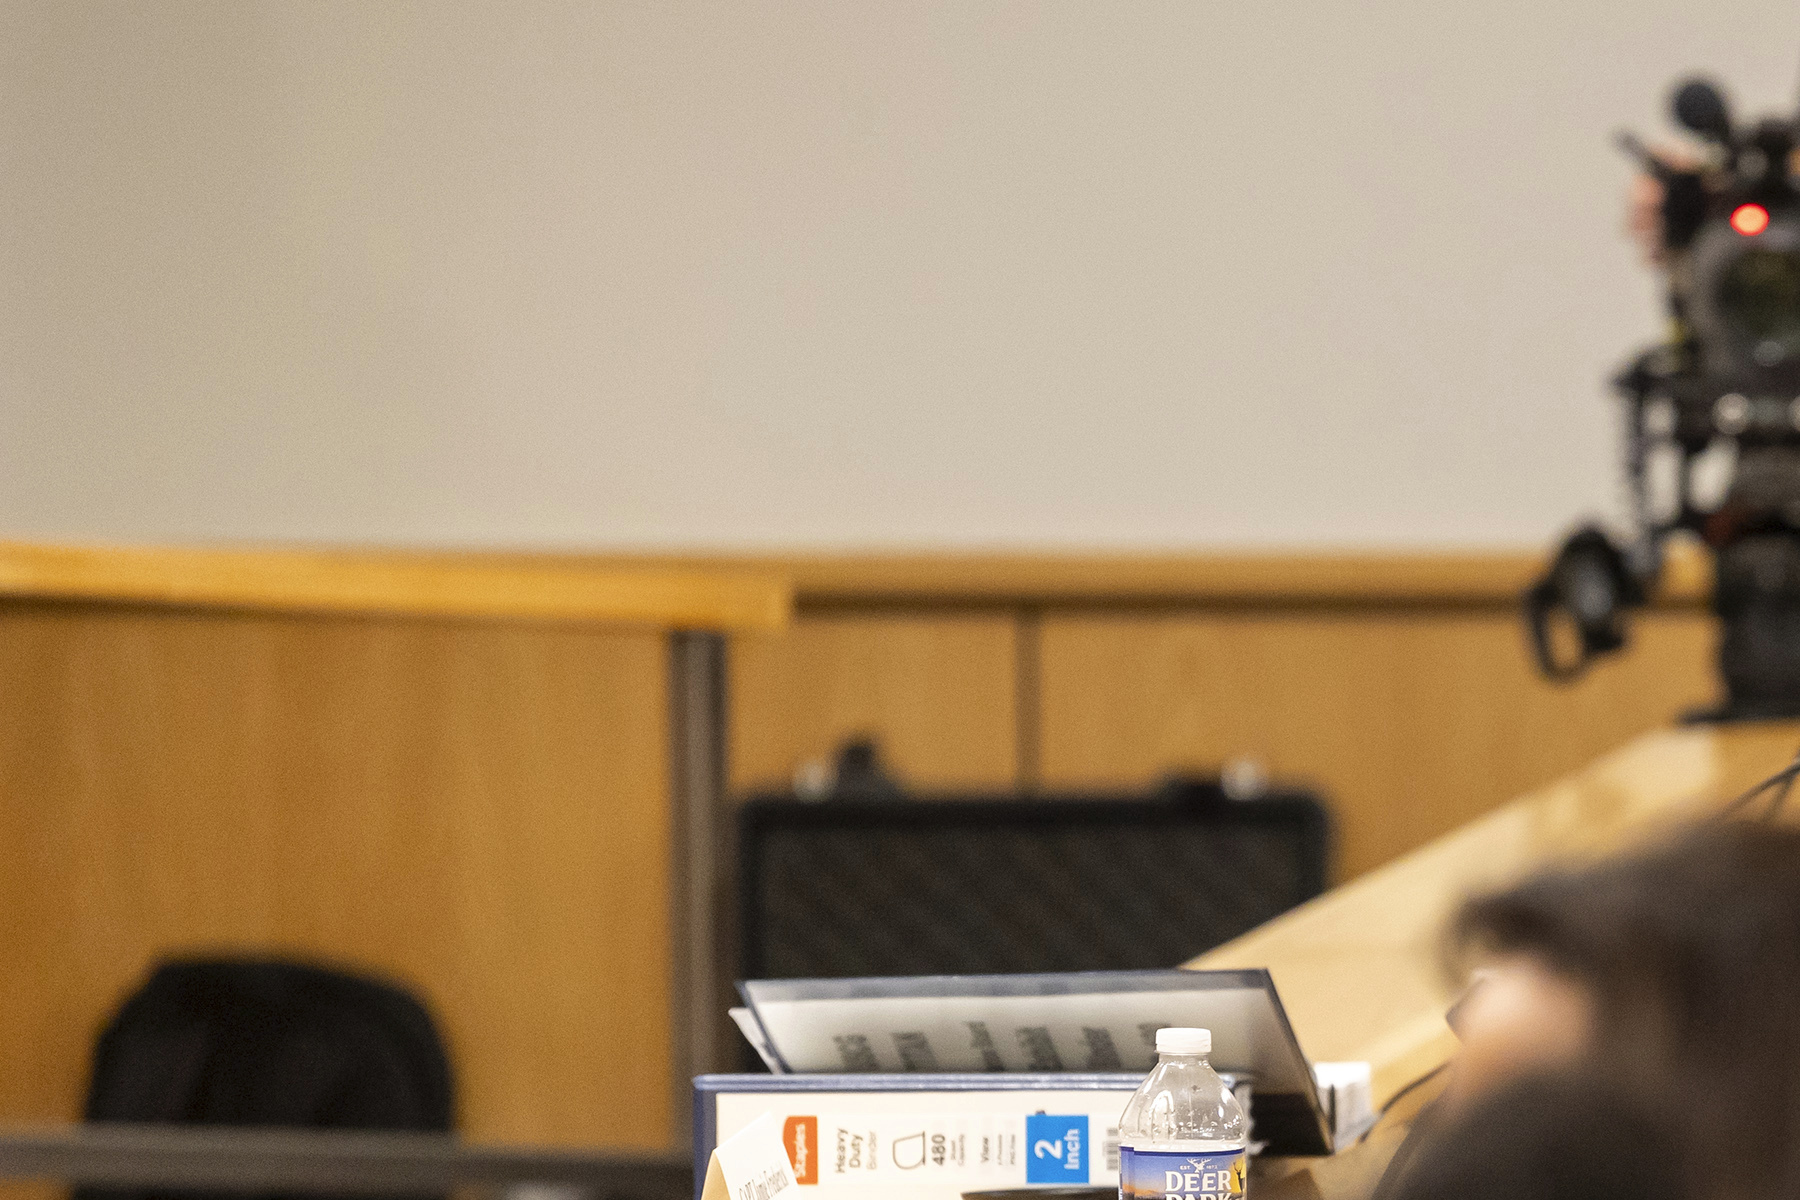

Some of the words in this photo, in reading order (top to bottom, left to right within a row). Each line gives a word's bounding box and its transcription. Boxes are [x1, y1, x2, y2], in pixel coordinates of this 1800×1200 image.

[835, 1128, 848, 1173] Heavy
[849, 1134, 863, 1168] Duty
[931, 1134, 946, 1166] 480
[1034, 1139, 1063, 1159] 2
[1063, 1128, 1080, 1170] Inch
[1165, 1170, 1231, 1192] DEER
